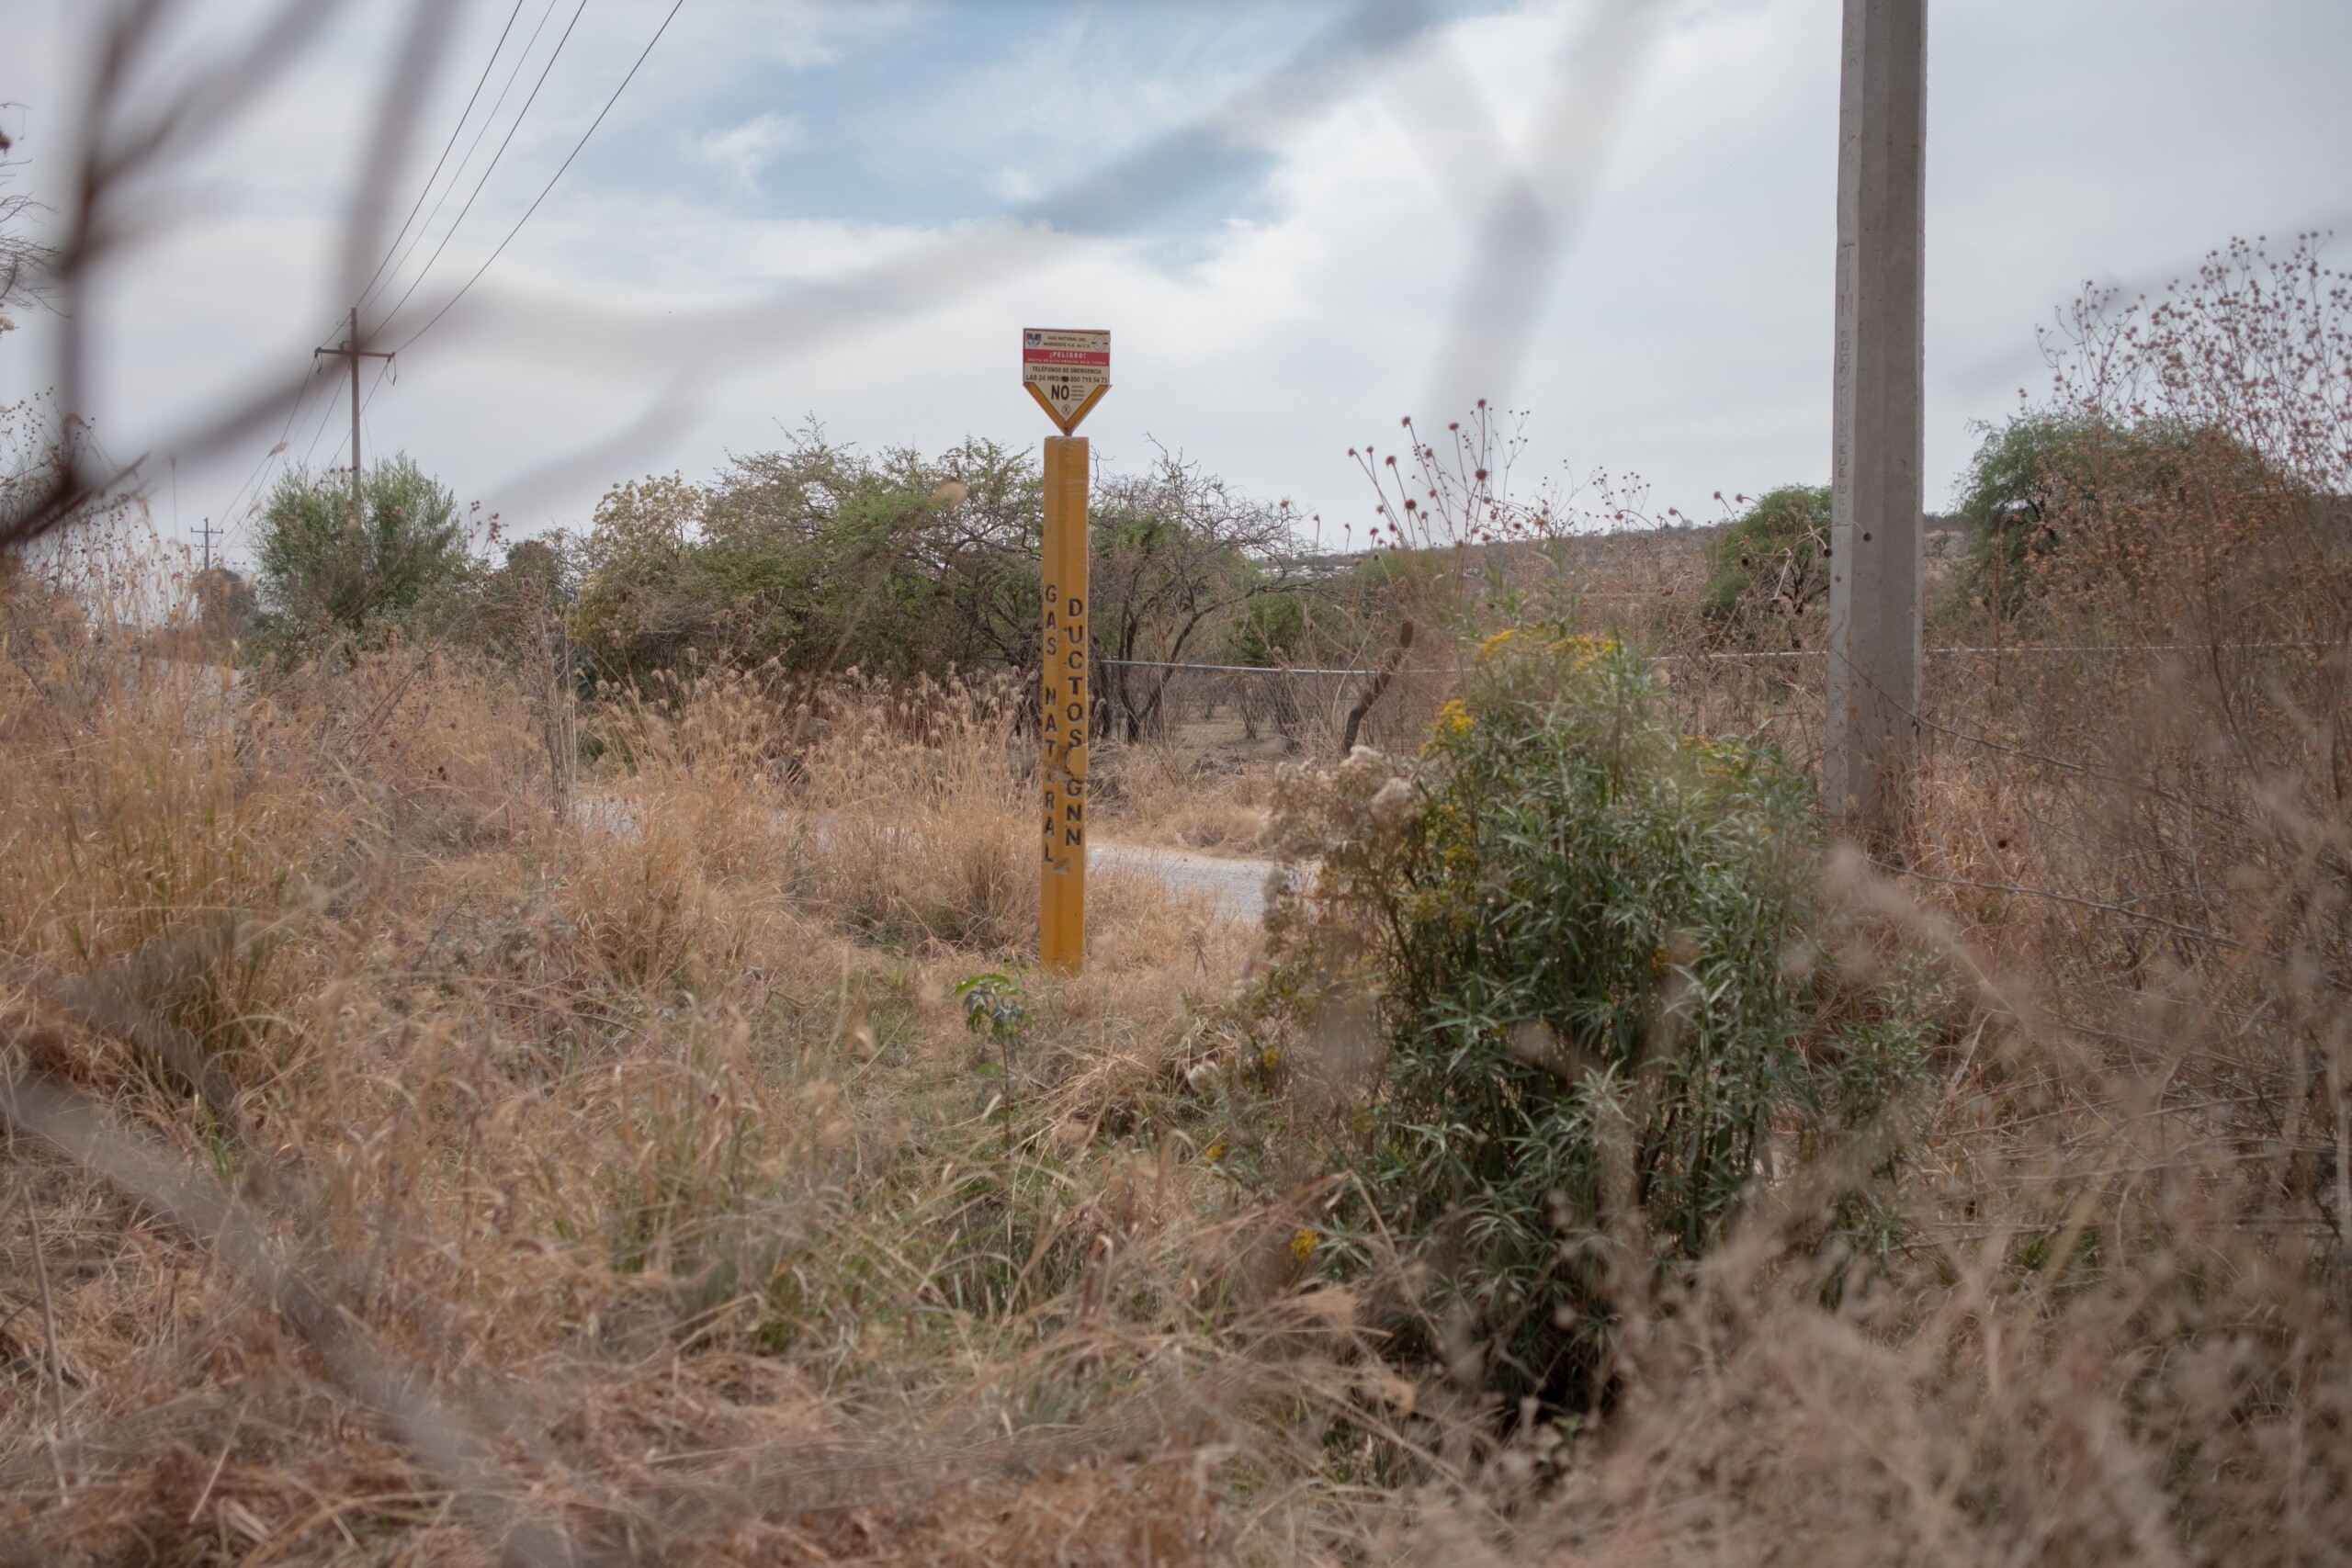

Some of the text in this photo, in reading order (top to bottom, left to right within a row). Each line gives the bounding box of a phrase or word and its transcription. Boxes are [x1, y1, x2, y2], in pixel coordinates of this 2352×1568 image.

[1051, 385, 1069, 400] NO
[1045, 583, 1057, 657] GAS
[1065, 598, 1083, 847] DUCTOS GNN
